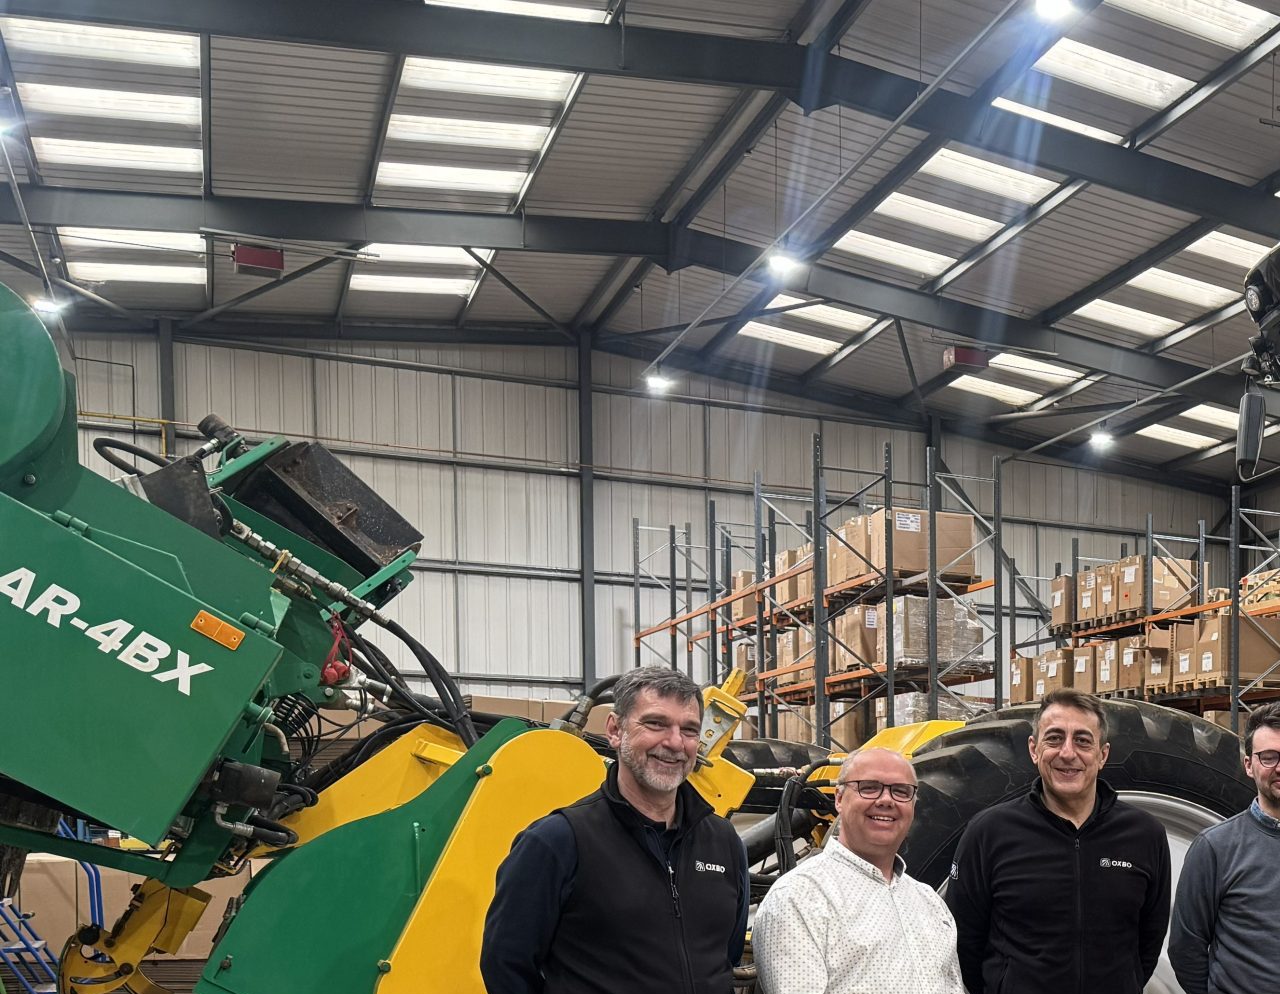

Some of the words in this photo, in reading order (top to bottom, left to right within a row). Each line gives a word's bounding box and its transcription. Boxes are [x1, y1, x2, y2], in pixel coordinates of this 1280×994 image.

[0, 567, 215, 696] AR-4BX
[705, 863, 726, 873] OXBO
[1111, 860, 1132, 868] OXBO
